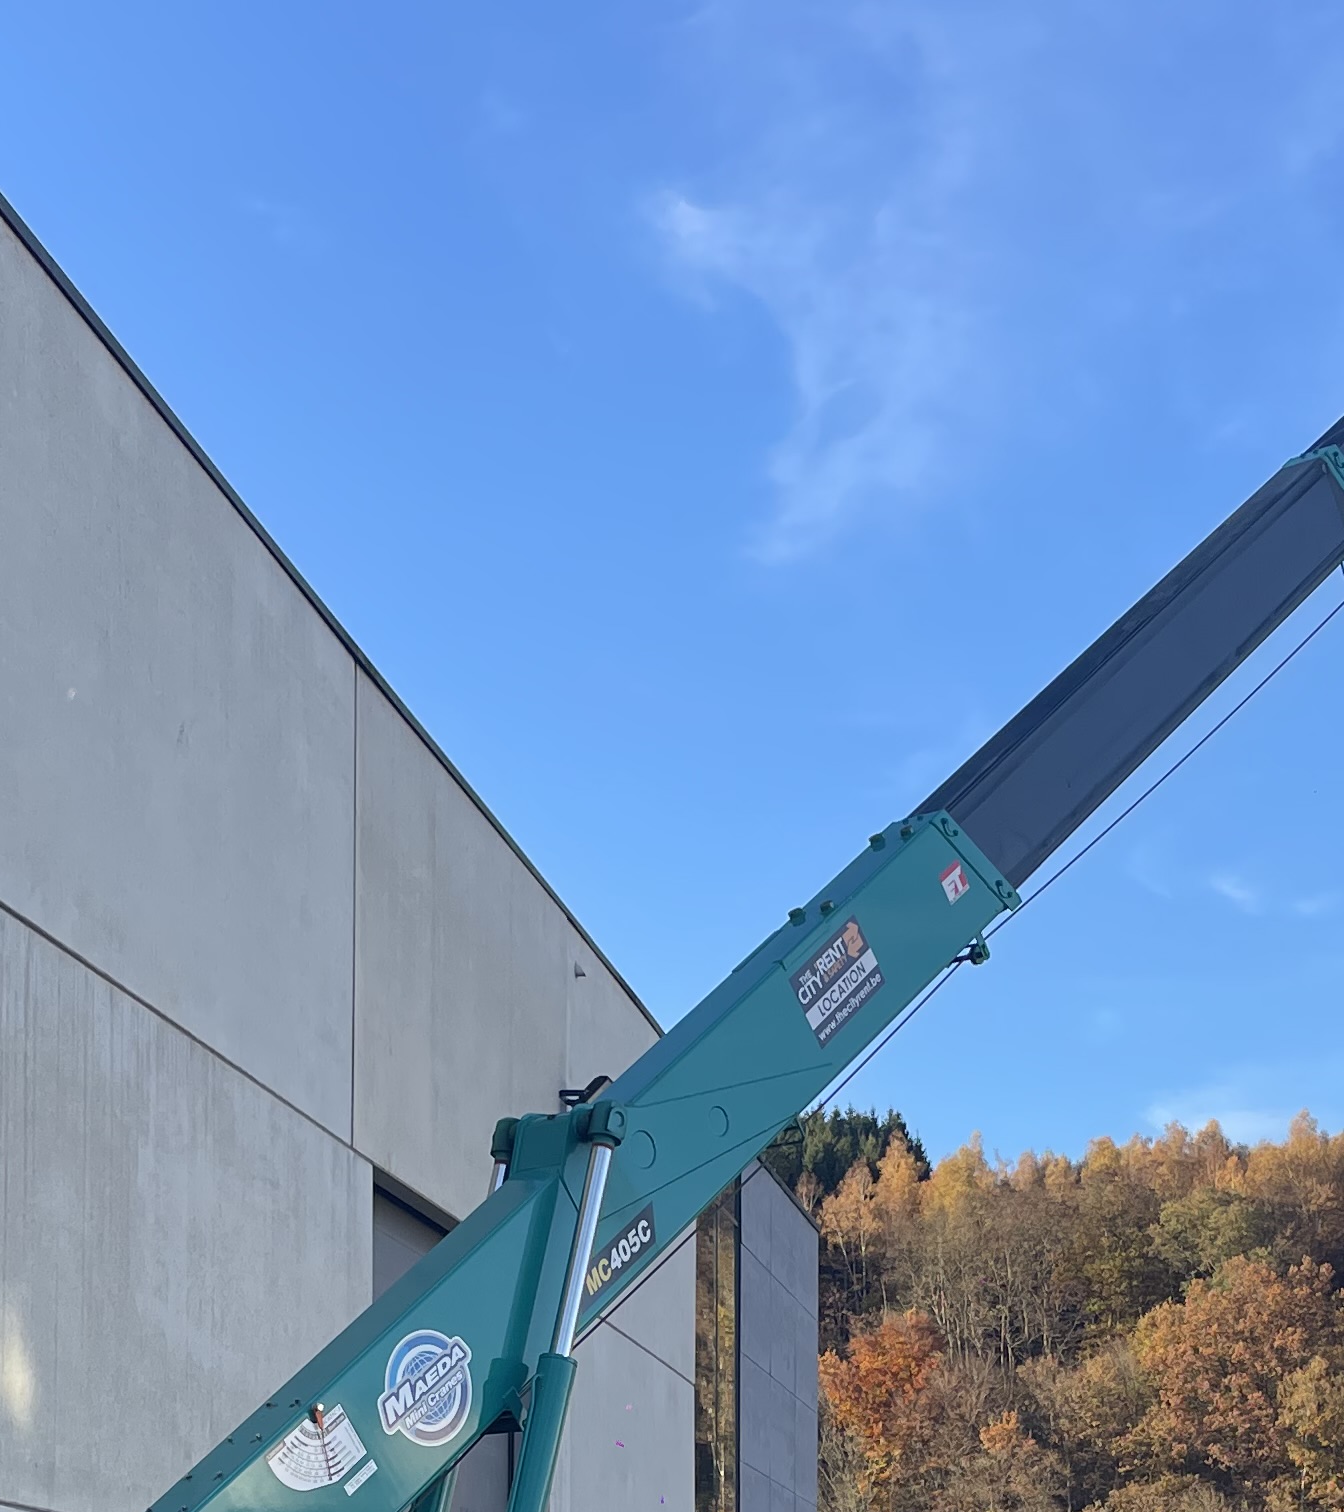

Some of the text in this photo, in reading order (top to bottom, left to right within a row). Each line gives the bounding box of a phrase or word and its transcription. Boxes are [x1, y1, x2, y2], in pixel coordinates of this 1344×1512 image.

[799, 969, 813, 984] THE
[817, 961, 867, 1017] LOCATION
[818, 973, 882, 1041] www.thecityrent.be
[586, 1220, 651, 1296] MC405C
[384, 1345, 465, 1425] MAEDA
[405, 1370, 463, 1429] Mini Cranes
